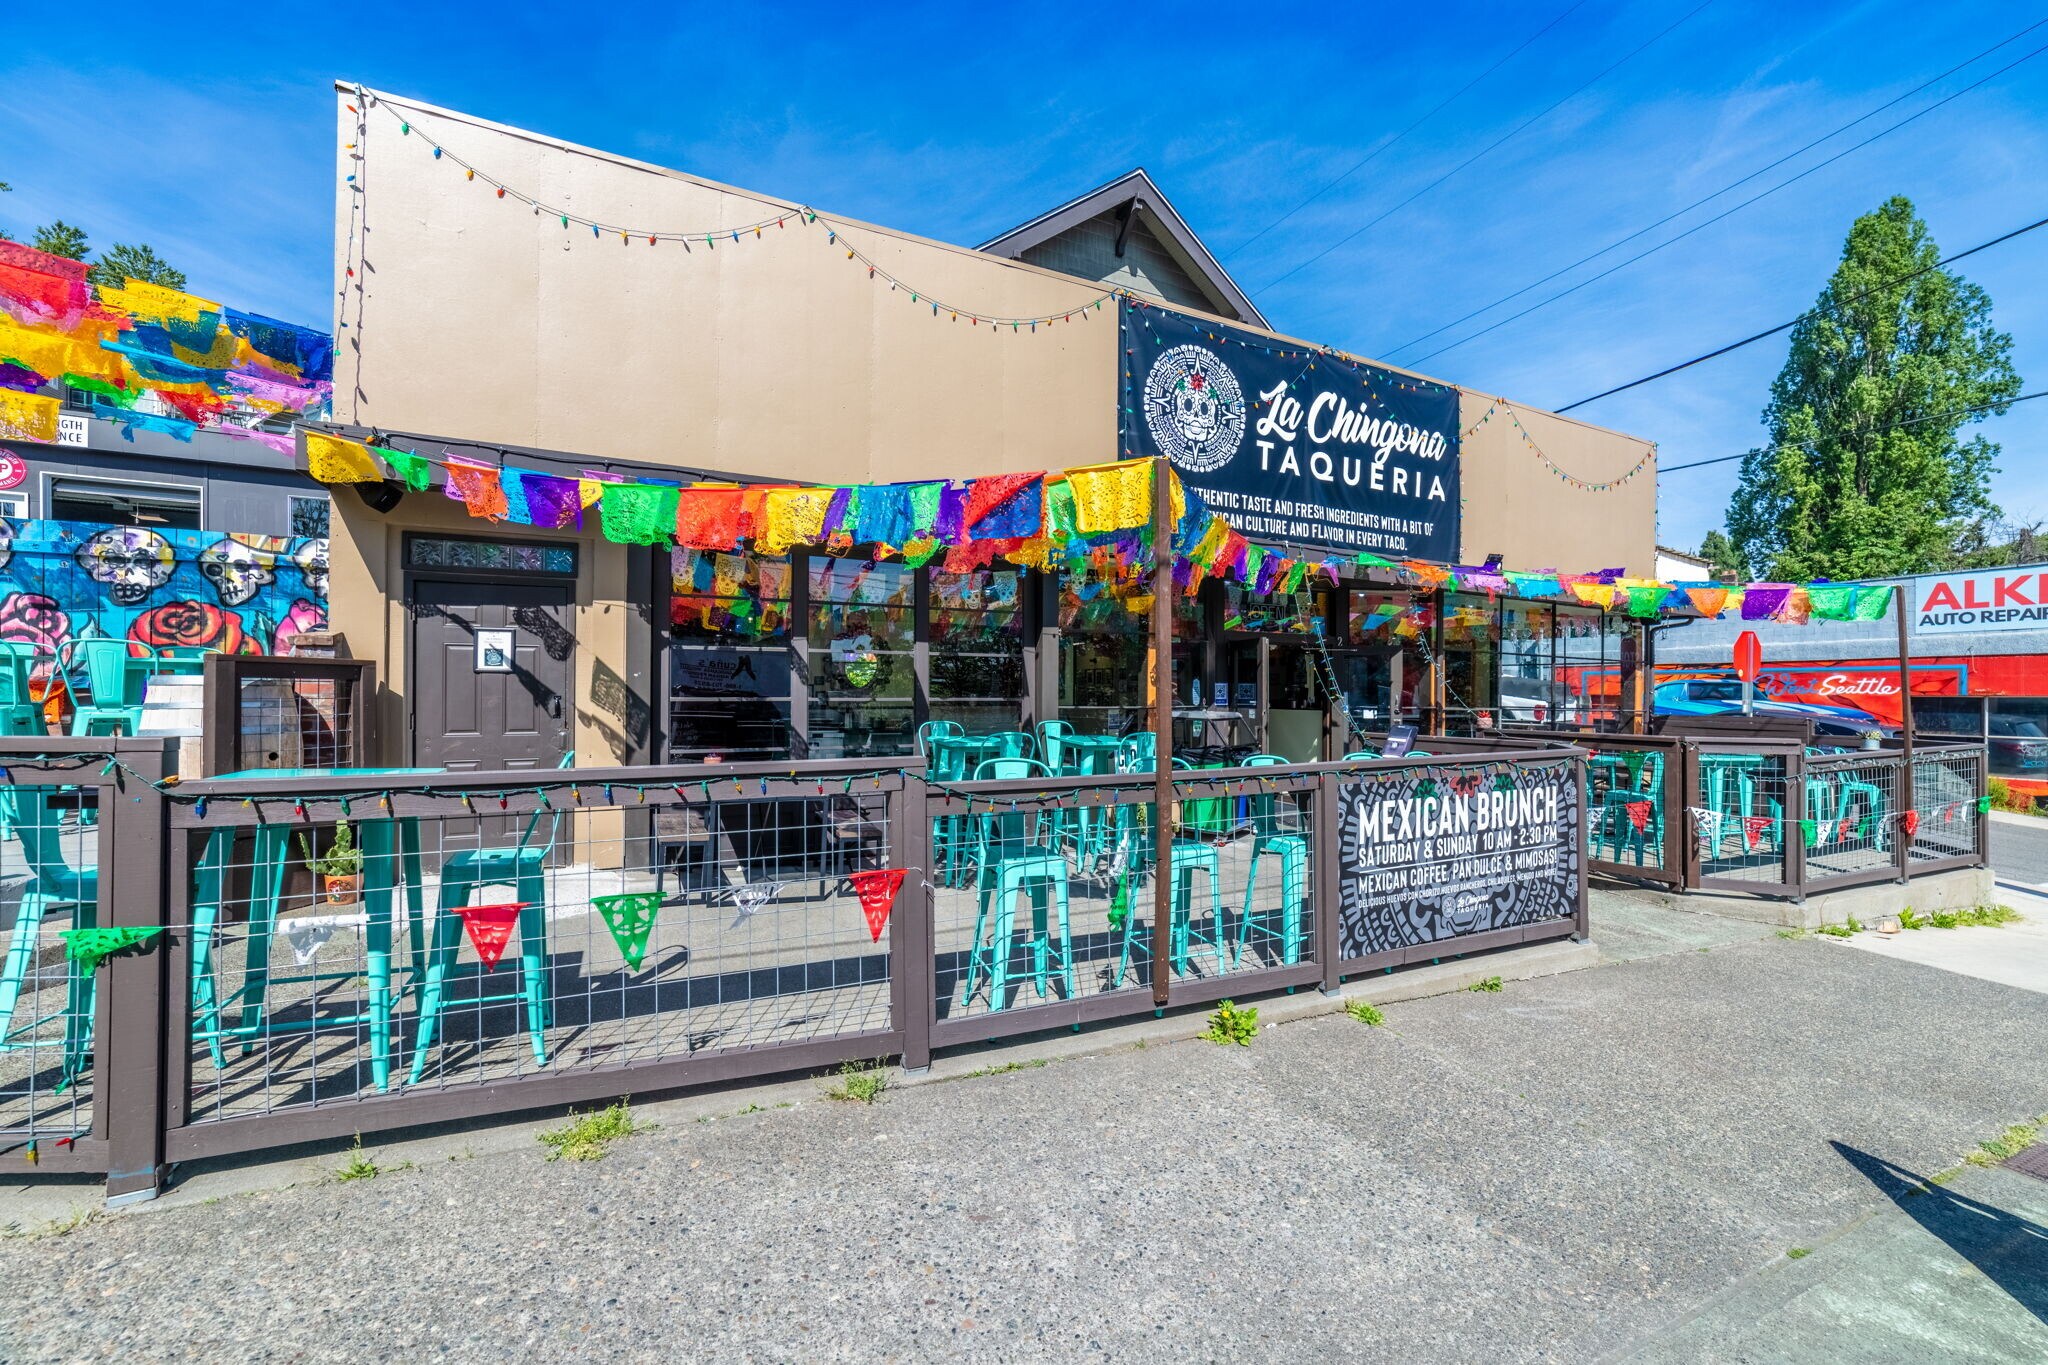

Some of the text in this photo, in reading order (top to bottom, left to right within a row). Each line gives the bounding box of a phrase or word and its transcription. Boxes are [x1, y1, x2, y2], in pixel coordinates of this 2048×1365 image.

[1256, 380, 1447, 464] La Chingona
[1256, 440, 1446, 502] TAQUERIA
[1242, 494, 1272, 513] TASTE
[1275, 499, 1293, 516] AND
[1295, 502, 1325, 520] FRESH
[1326, 507, 1380, 529] INGREDIENTS
[1380, 516, 1400, 532] WITH
[1402, 519, 1408, 533] A
[1410, 520, 1422, 535] BIT
[1424, 523, 1434, 536] OF
[1245, 515, 1287, 535] CULTURE
[1290, 522, 1309, 537] AND
[1312, 523, 1344, 542] FLAVOR
[1346, 528, 1355, 544] IN
[1357, 531, 1383, 548] EVERY
[1384, 534, 1408, 551] TACO.
[1921, 573, 2048, 612] ALKI
[1919, 611, 1976, 627] AUTO
[1753, 672, 1901, 696] West Seattle
[1359, 786, 1557, 845] MEXICAN BRUNCH
[1359, 841, 1420, 868] SATURDAY
[1423, 839, 1433, 859] &
[1436, 833, 1478, 857] SUNDAY
[1482, 832, 1494, 850] 10
[1496, 831, 1512, 849] AM
[1519, 825, 1541, 845] 2:30
[1543, 824, 1557, 842] PM
[1359, 847, 1557, 894] MEXICAN COFFEE, PAN DULCE & MIMOSAS!
[1359, 896, 1386, 908] DELICIOUS
[1386, 893, 1407, 904] HUEVOS
[1408, 891, 1418, 901] CON
[1535, 869, 1544, 878] AND
[1457, 902, 1489, 914] TAQUERIA
